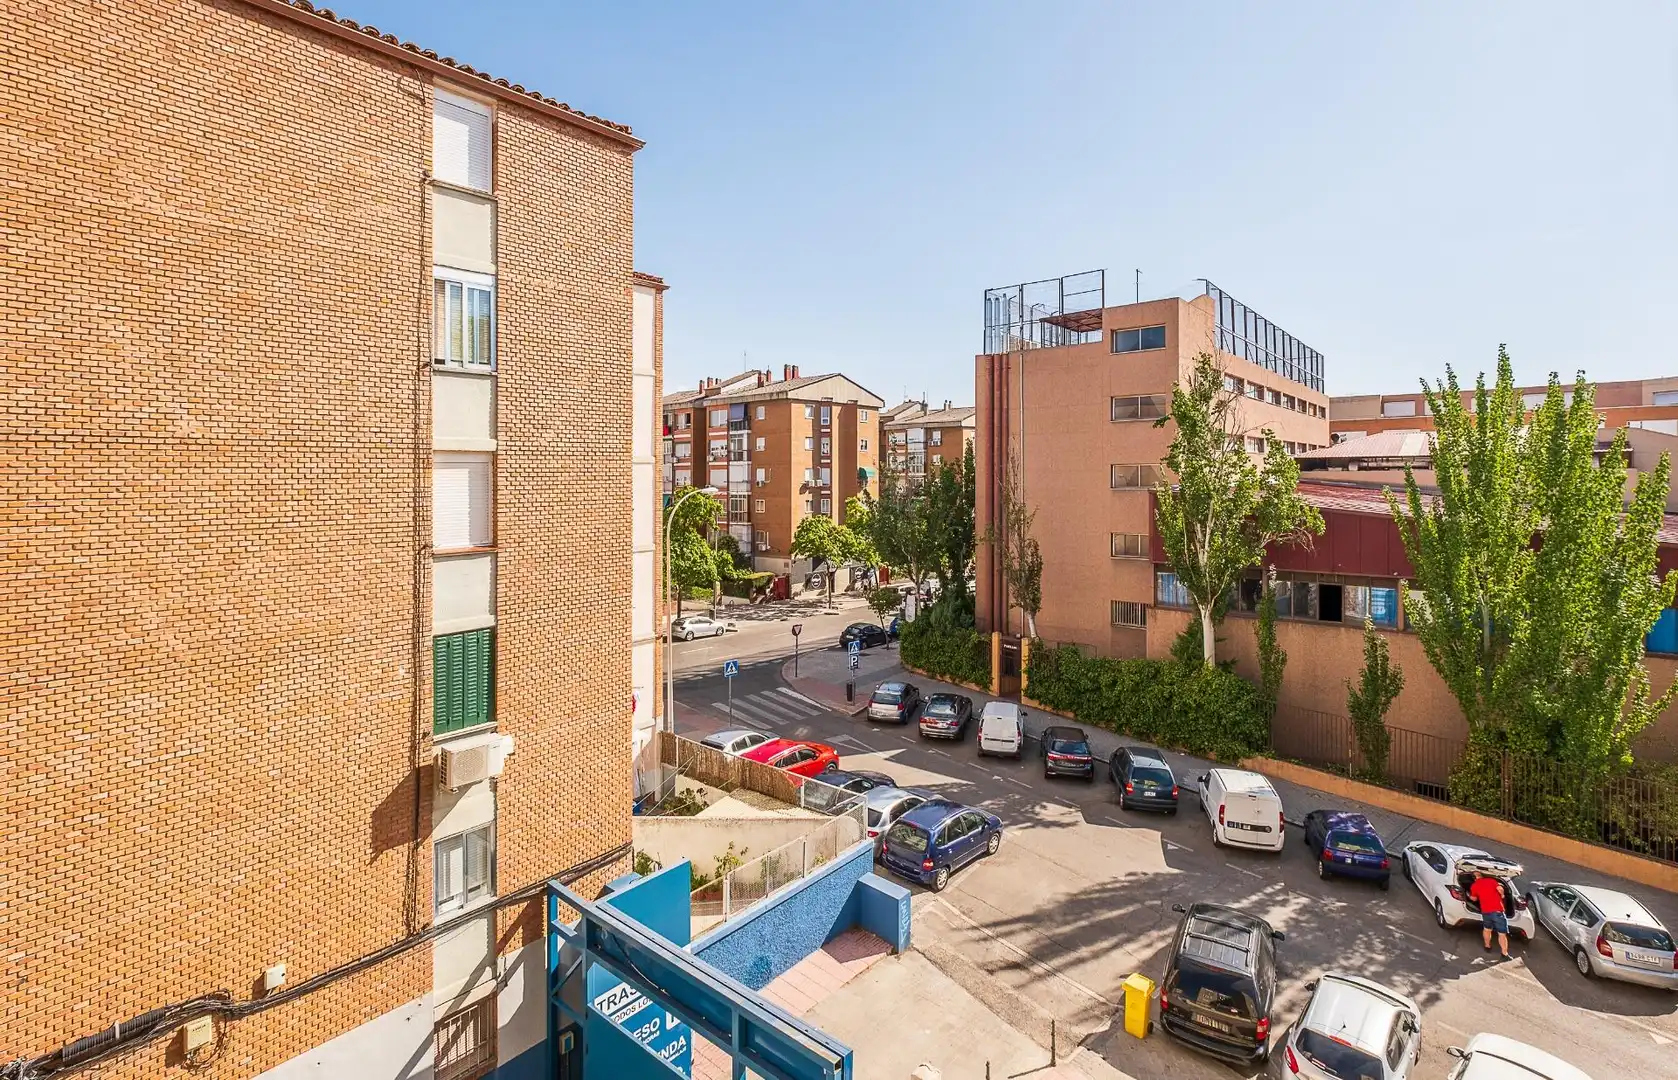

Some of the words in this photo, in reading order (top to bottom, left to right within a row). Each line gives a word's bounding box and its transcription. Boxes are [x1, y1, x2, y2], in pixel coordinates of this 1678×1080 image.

[851, 656, 858, 667] P
[613, 1005, 636, 1022] ODOS
[638, 998, 652, 1009] LO
[633, 1017, 660, 1038] ESO
[658, 1035, 686, 1059] NDA
